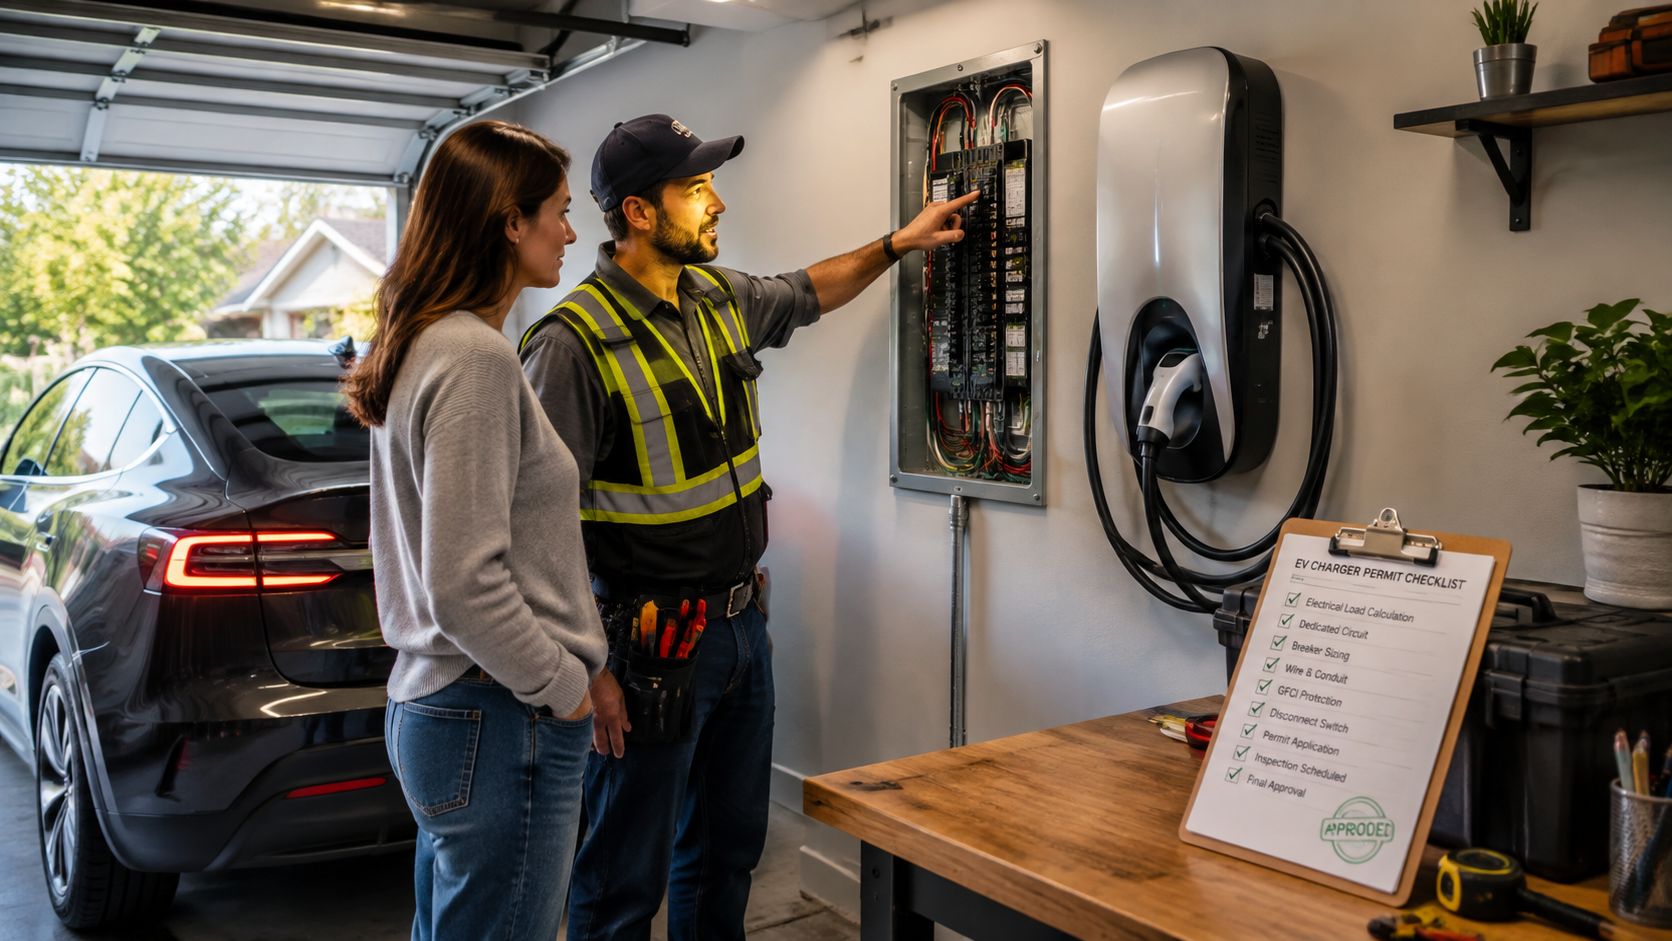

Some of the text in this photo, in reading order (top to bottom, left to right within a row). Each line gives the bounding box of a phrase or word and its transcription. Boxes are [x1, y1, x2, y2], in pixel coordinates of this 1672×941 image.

[1295, 558, 1467, 590] EV CHARGER PERMIT CHECKLIST
[1306, 597, 1414, 623] Electrical Load Calculation
[1299, 620, 1368, 640] Dedicated Circuit
[1292, 641, 1350, 662] Breaker Sizing
[1285, 663, 1348, 684] Wire & Conduit
[1277, 685, 1299, 698] GFCI
[1269, 708, 1349, 734] Disconnect Switch
[1262, 730, 1340, 756] Permit Application
[1254, 752, 1347, 783] Inspection Scheduled
[1247, 774, 1307, 798] Final Approval
